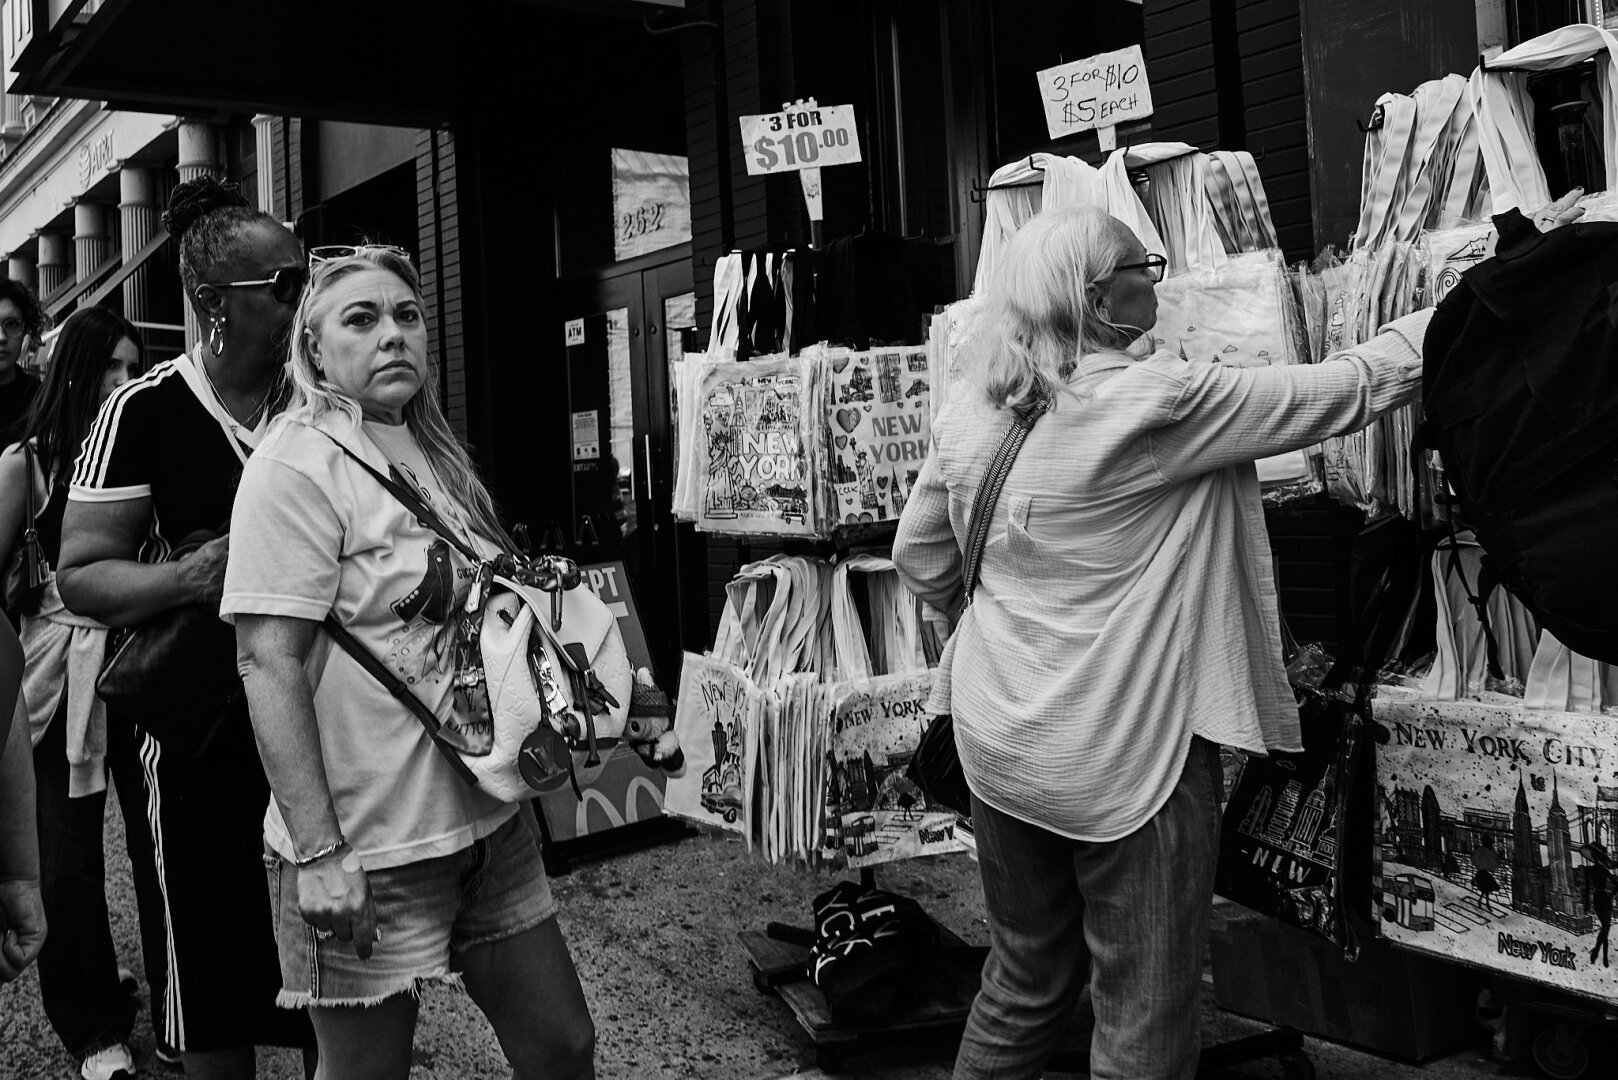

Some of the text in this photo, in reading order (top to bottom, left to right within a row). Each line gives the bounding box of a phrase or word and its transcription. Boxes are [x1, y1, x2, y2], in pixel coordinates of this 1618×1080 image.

[1051, 63, 1139, 102] 3 FOR $10
[768, 110, 822, 132] 3 FOR
[1061, 93, 1137, 127] $5 EACH
[621, 202, 662, 242] 262
[568, 326, 582, 339] ATM
[872, 413, 922, 437] NEW
[741, 432, 797, 455] NEW
[456, 567, 477, 580] GUCC
[844, 699, 926, 729] NEW YORK
[1396, 721, 1606, 770] NEW YORK CITY
[1497, 931, 1577, 971] New York
